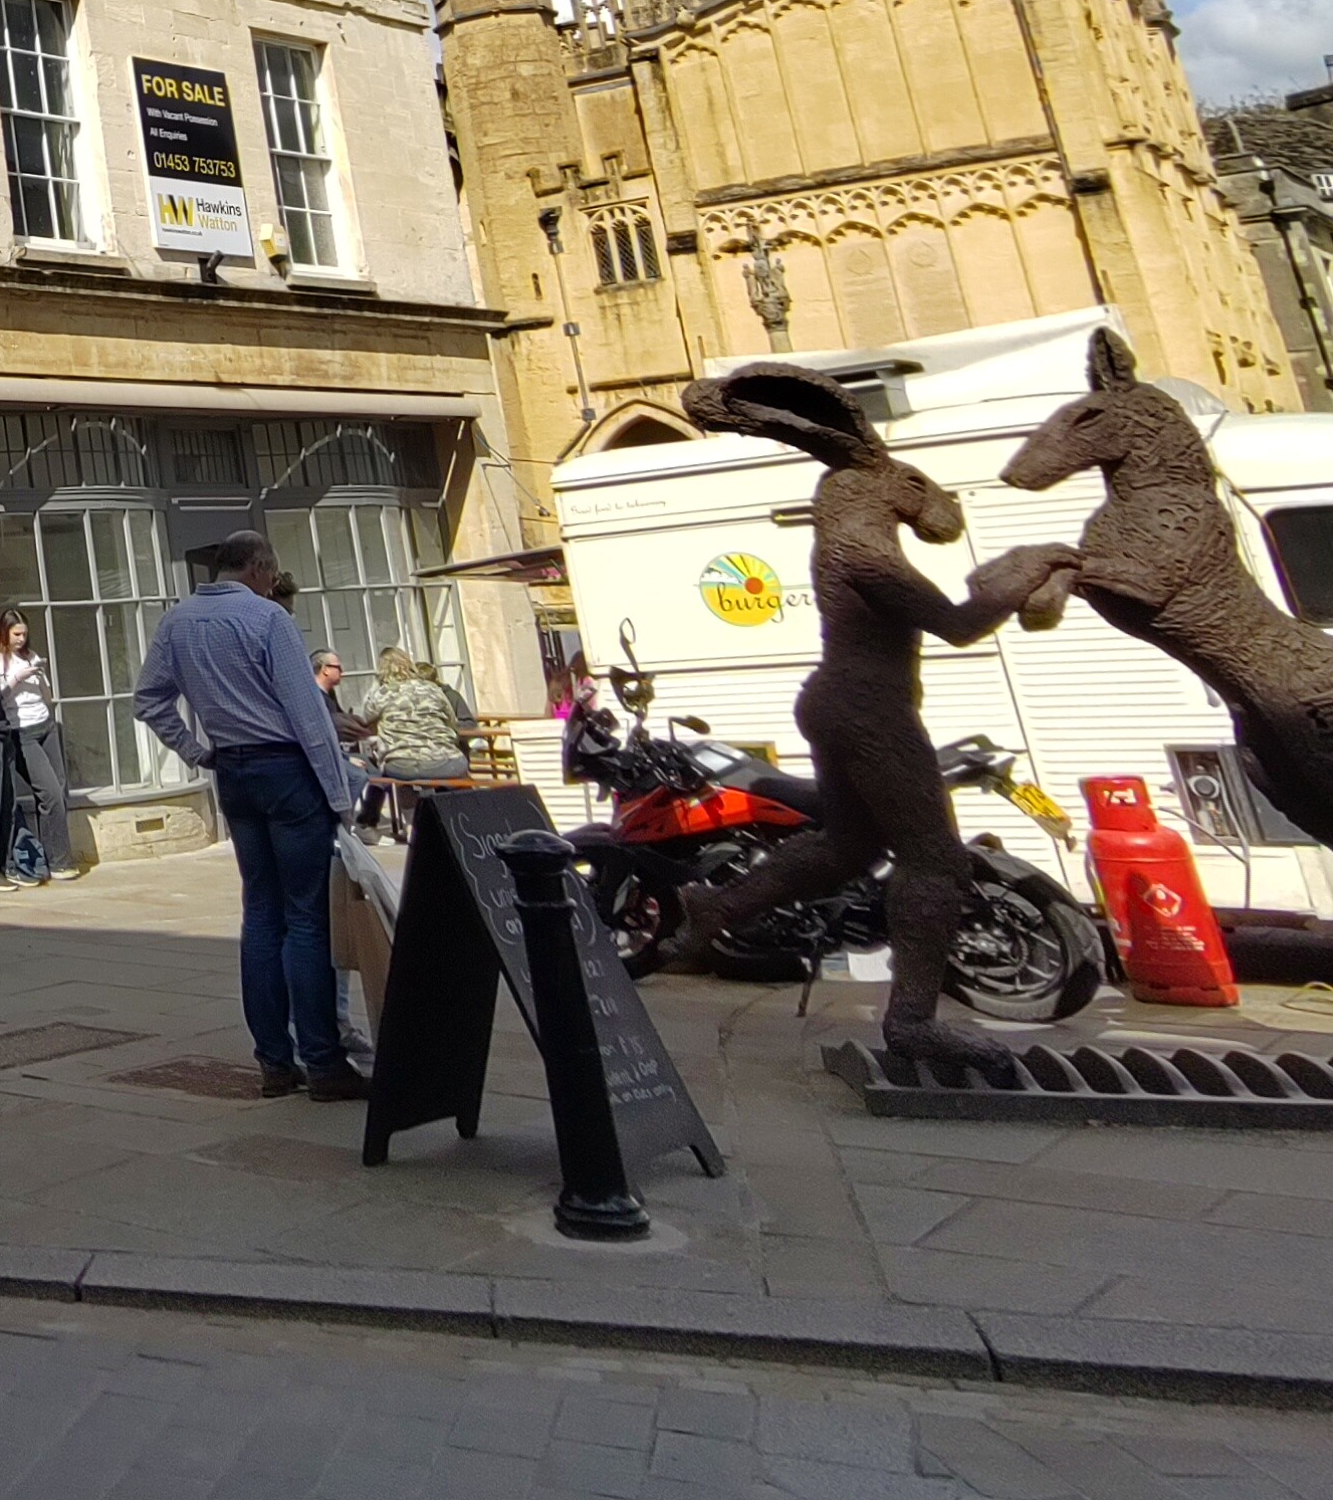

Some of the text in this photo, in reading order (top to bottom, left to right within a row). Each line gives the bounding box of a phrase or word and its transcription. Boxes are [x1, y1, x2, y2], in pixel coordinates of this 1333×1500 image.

[141, 74, 226, 107] FOR SALE
[146, 107, 163, 118] With
[162, 109, 184, 121] Vacant
[153, 151, 236, 178] 01453 753753
[196, 198, 242, 217] Hawkins
[198, 214, 238, 232] Watton
[717, 581, 812, 623] burger
